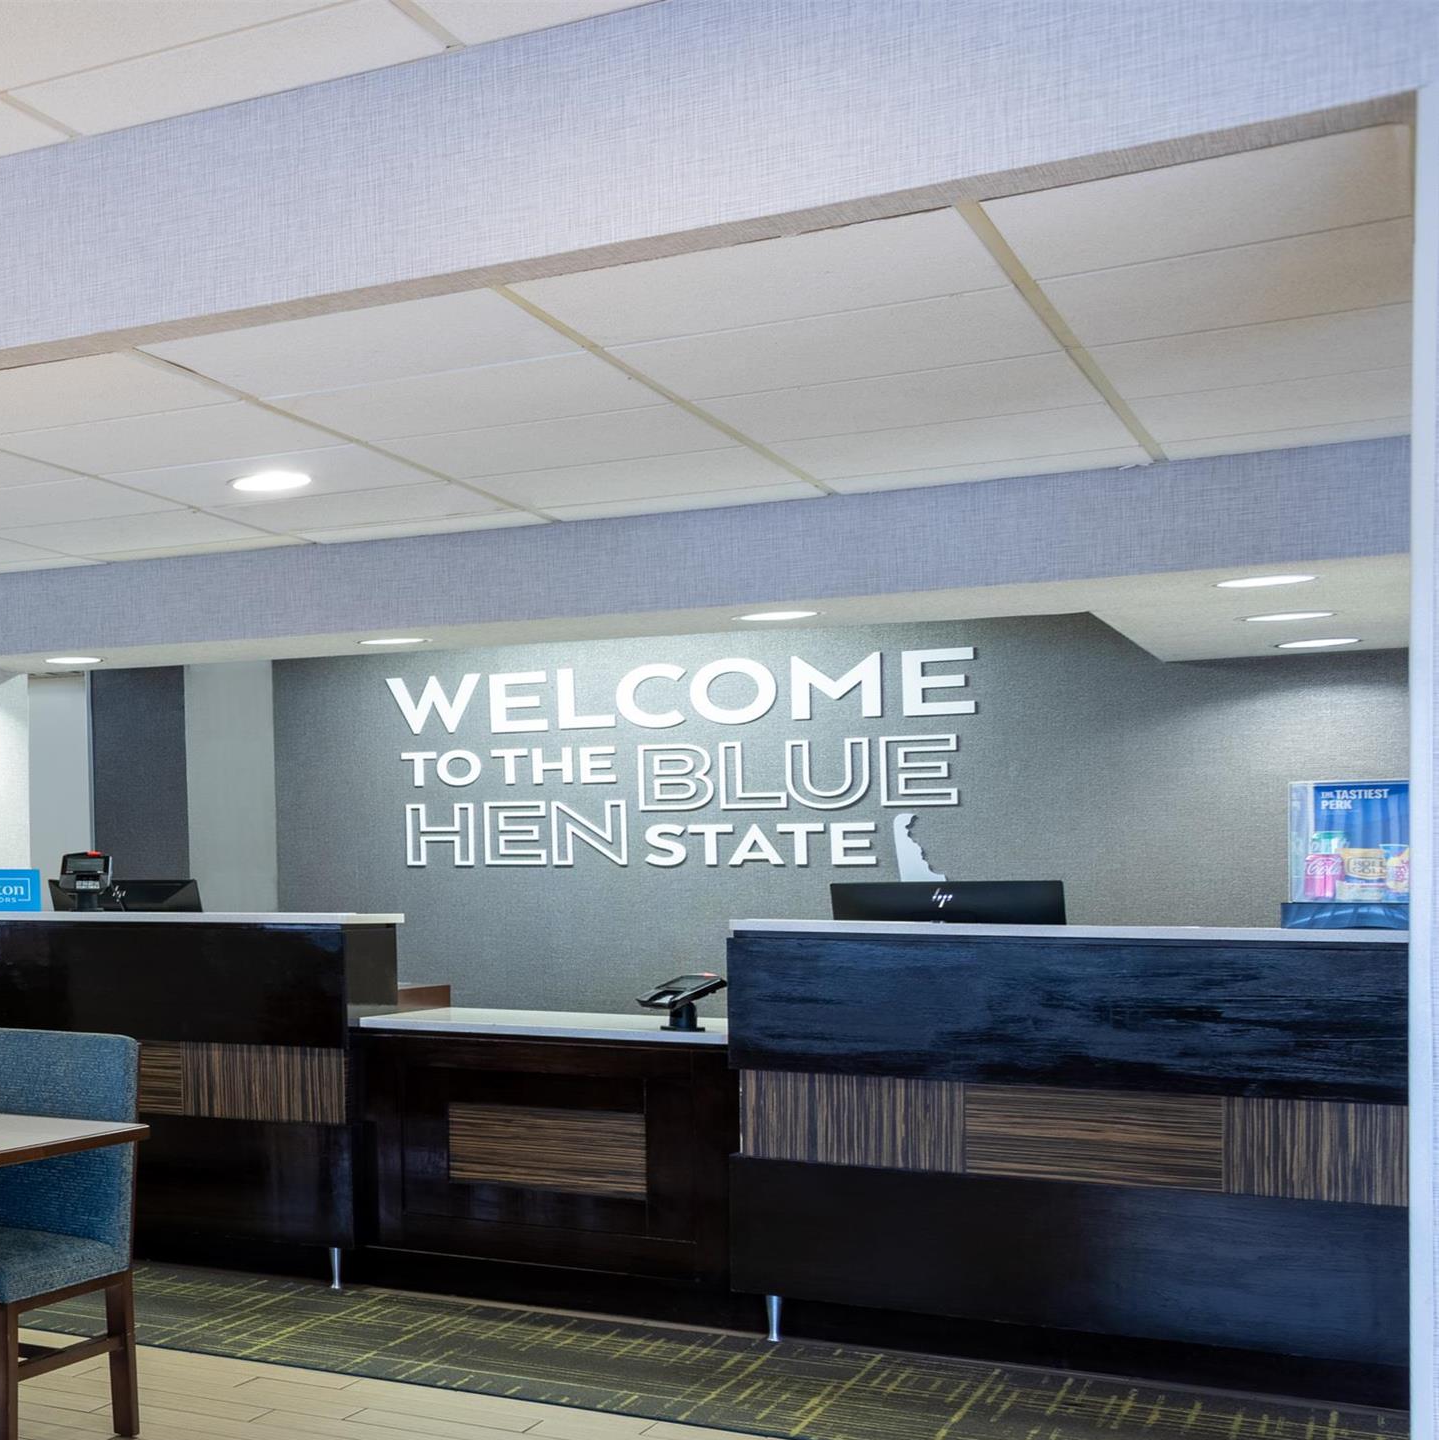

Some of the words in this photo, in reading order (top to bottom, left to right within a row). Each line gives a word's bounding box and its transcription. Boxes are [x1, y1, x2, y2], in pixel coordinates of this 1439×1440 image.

[385, 647, 975, 734] WELCOME
[401, 750, 481, 787] TO
[490, 746, 617, 784] THE
[637, 734, 959, 812] BLUE
[1335, 788, 1389, 800] TASTIEST
[1321, 799, 1352, 810] PERK
[406, 800, 628, 867] HEN
[644, 822, 877, 867] STATE
[932, 887, 953, 908] hp
